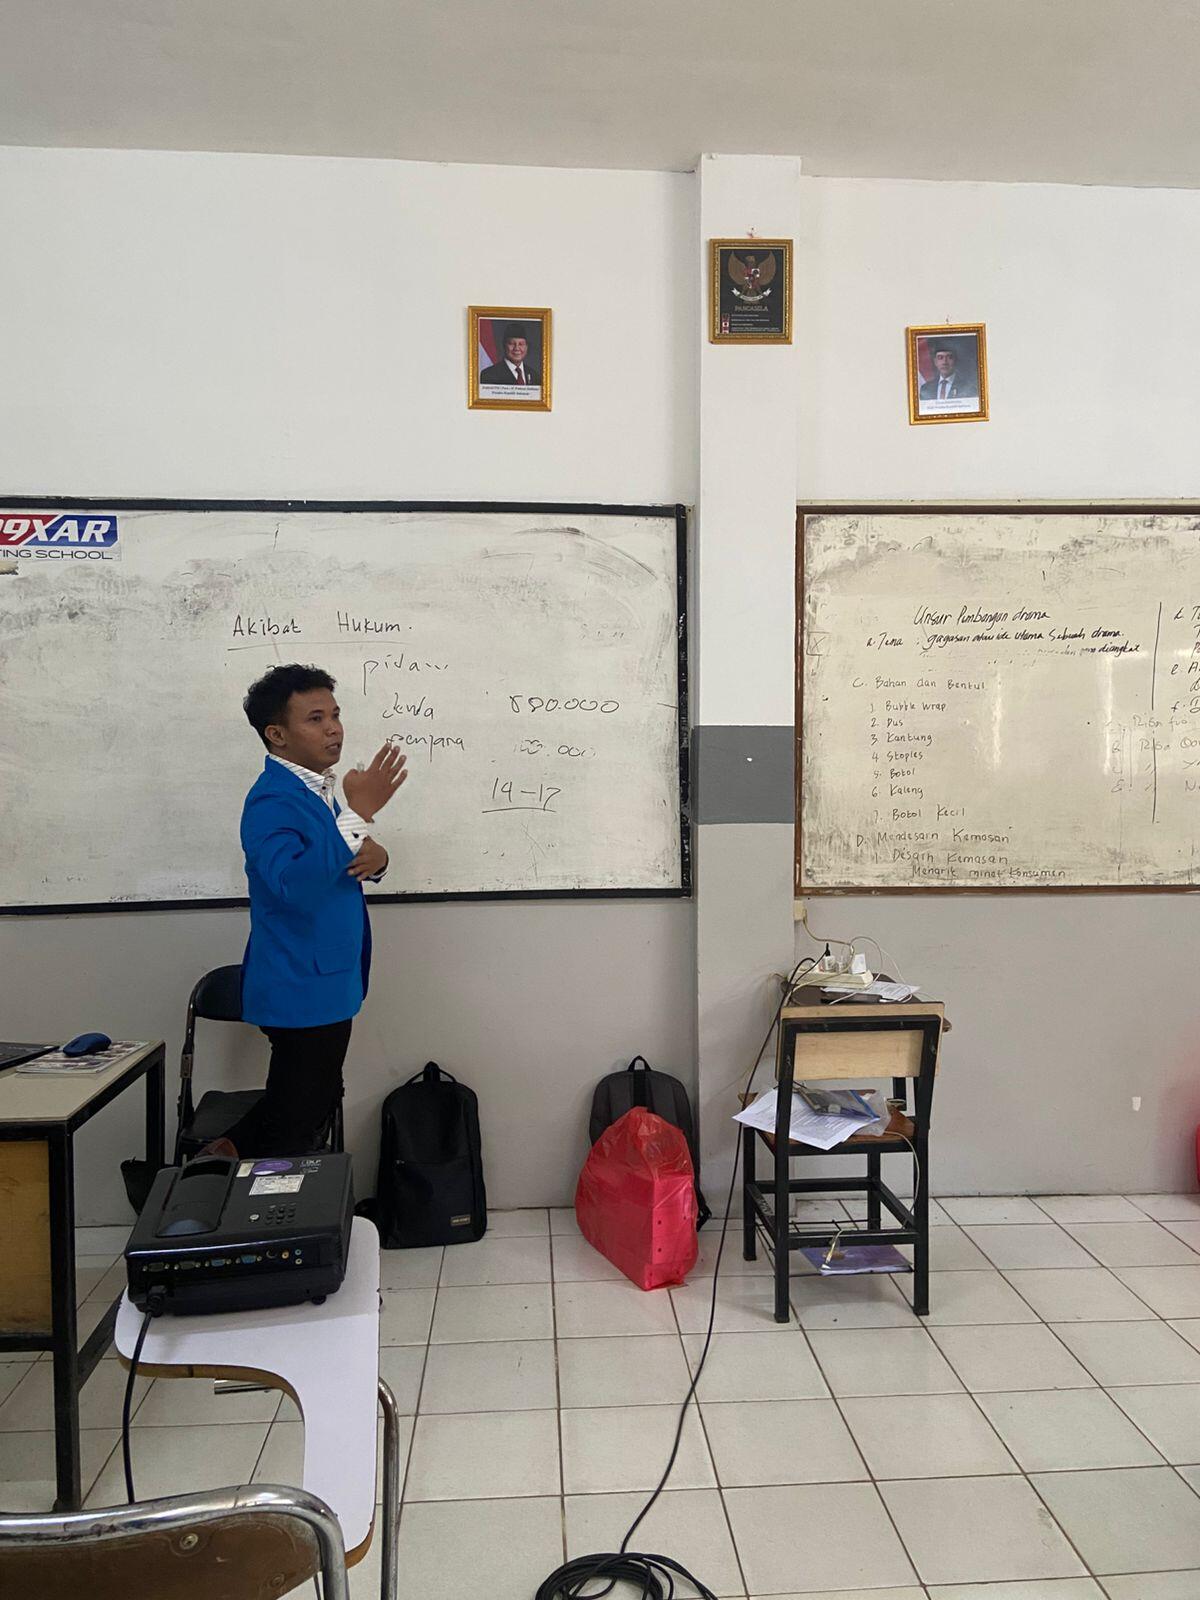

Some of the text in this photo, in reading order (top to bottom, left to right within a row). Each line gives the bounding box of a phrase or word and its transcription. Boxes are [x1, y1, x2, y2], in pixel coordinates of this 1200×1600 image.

[0, 519, 111, 543] 9XAR
[0, 549, 113, 560] ING SCHOOL
[913, 605, 953, 626] Unsur
[1012, 606, 1051, 622] drama
[232, 614, 302, 637] Akibat
[921, 633, 971, 651] gagasan
[875, 674, 907, 689] Bahan
[916, 678, 937, 688] dan
[886, 717, 904, 728] Dus
[887, 732, 933, 747] Kantung
[886, 750, 924, 762] Stoples
[889, 768, 916, 779] Botol
[889, 783, 924, 800] Kaleng
[892, 808, 922, 820] Botol
[936, 803, 966, 821] Kecil
[952, 828, 1010, 844] Kemasan
[946, 852, 1009, 866] Kemasan
[912, 864, 958, 878] Menarik
